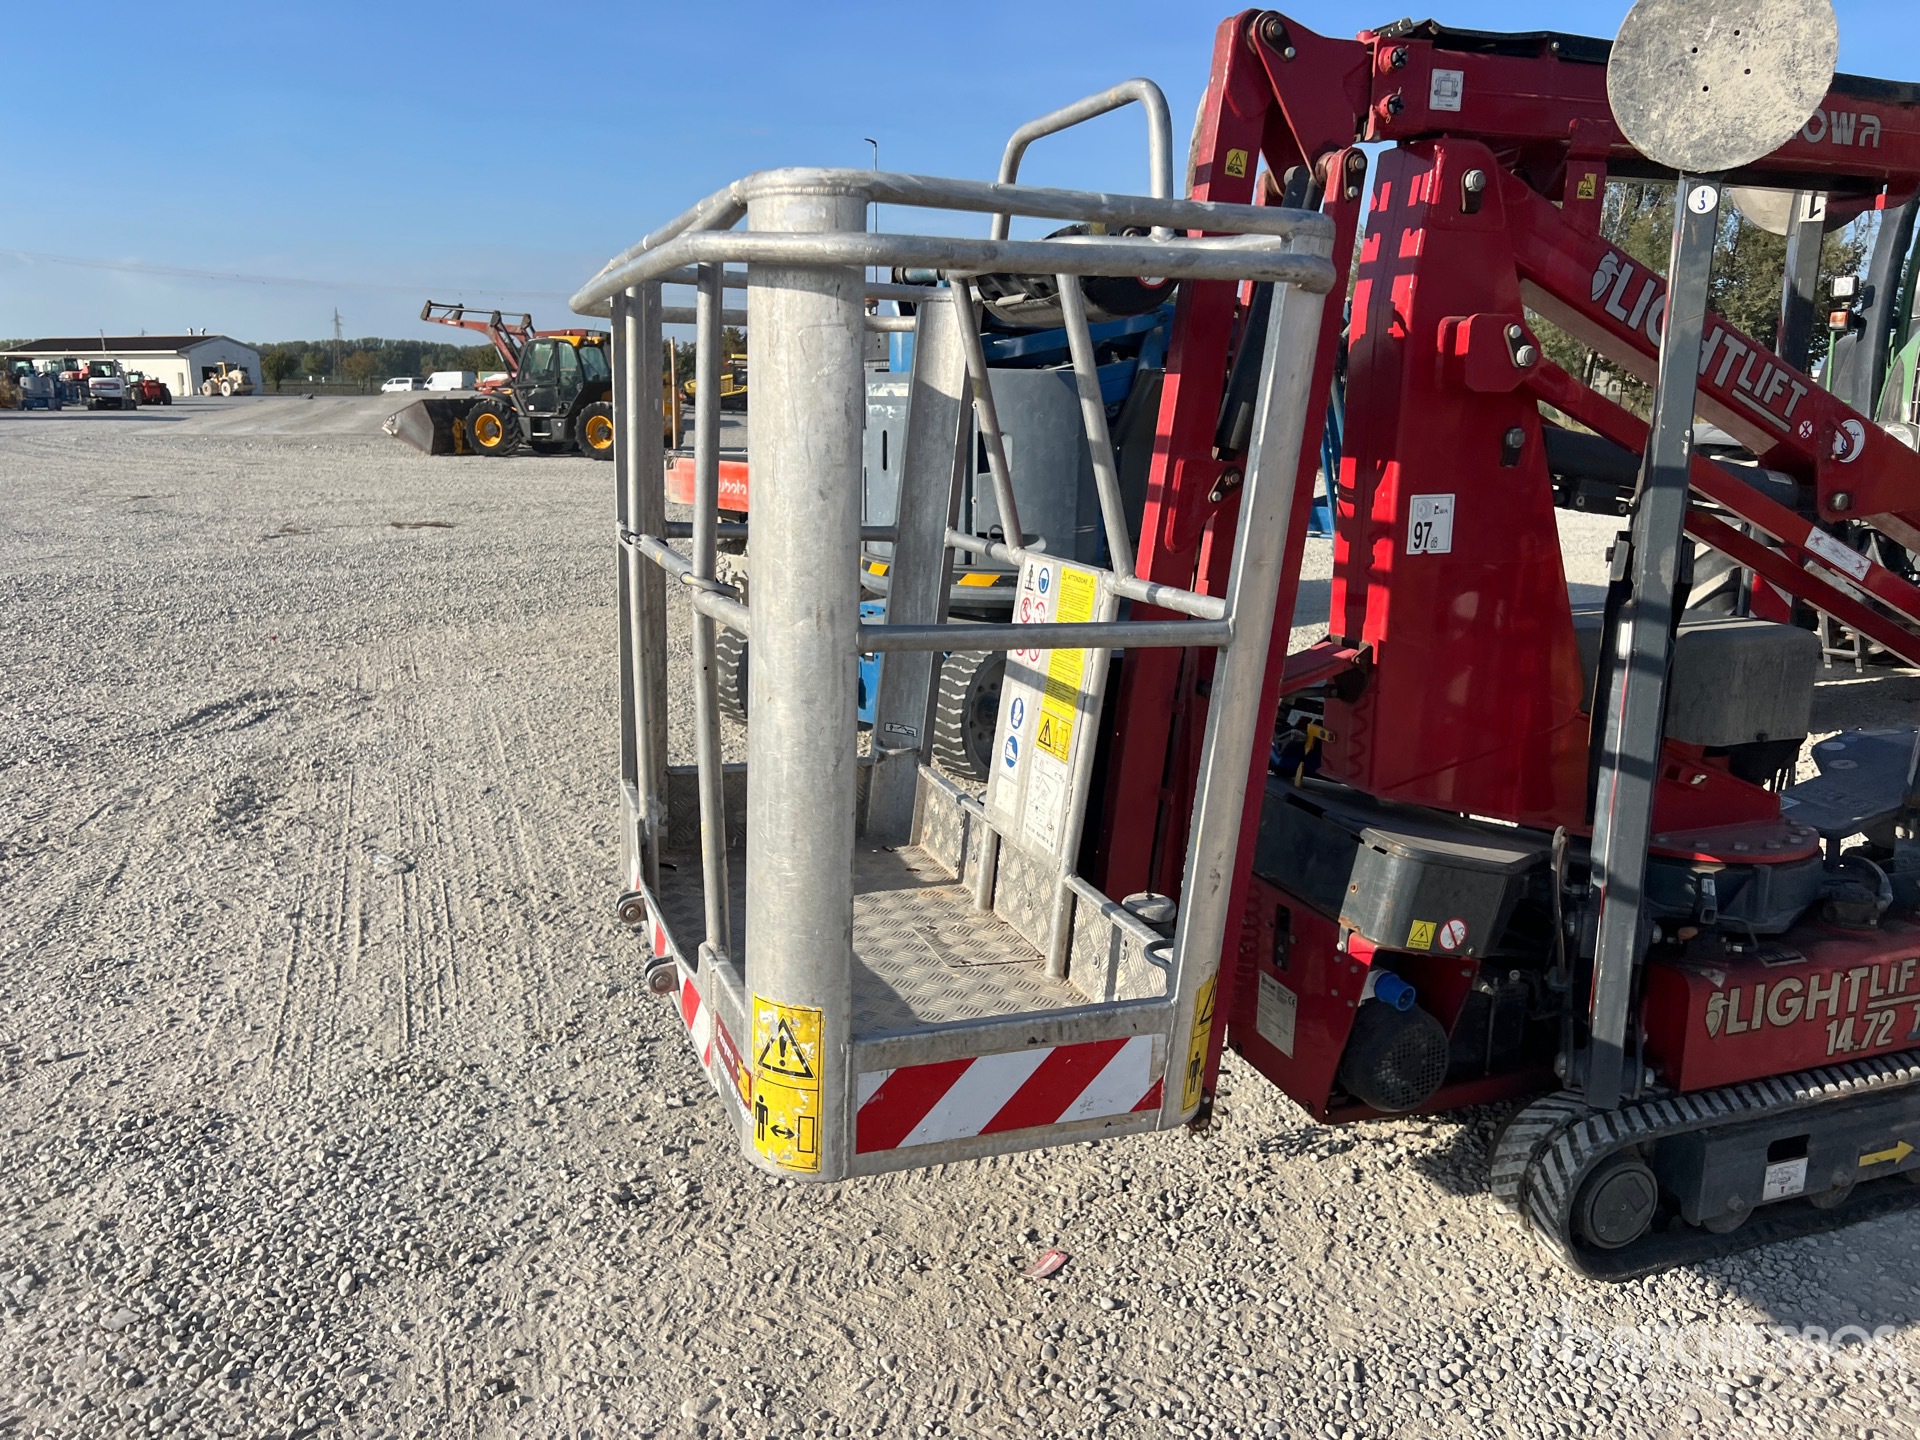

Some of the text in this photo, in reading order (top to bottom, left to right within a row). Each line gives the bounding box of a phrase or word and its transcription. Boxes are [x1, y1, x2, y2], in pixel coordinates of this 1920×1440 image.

[719, 478, 747, 495] ubota
[1413, 521, 1433, 549] 97
[1725, 958, 1920, 1034] LIGHTLIF
[1825, 1009, 1896, 1056] 14.72
